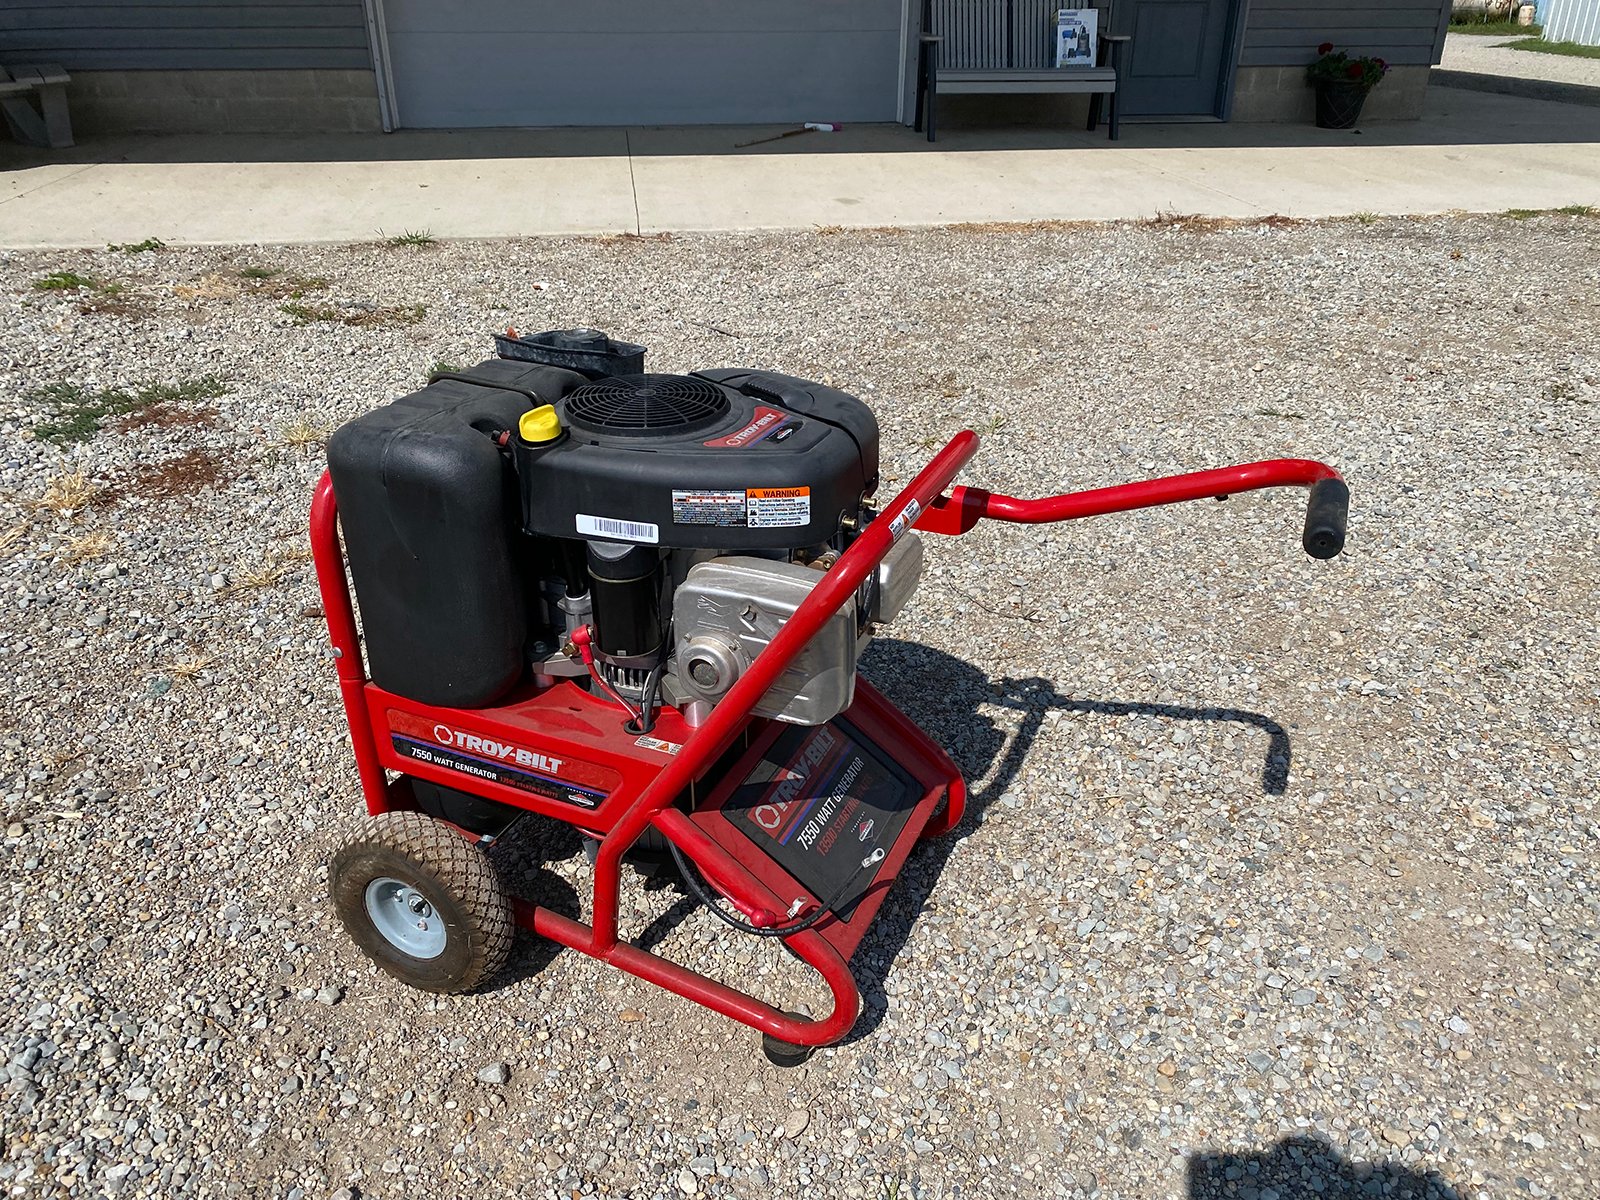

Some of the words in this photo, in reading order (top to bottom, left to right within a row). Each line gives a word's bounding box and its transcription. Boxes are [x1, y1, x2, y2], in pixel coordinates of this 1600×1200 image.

[734, 413, 777, 440] TROY-BILT
[763, 489, 801, 498] WARNING
[411, 747, 432, 761] 7550
[433, 755, 454, 768] WATT
[455, 761, 497, 780] GENERATOR
[453, 731, 564, 774] TROY-BILT
[769, 726, 836, 812] TROY-BILT
[796, 818, 822, 850] 7550
[815, 796, 837, 826] WATT
[831, 756, 865, 803] GENERATOR
[816, 828, 838, 857] 13500
[834, 797, 861, 833] STARTING
